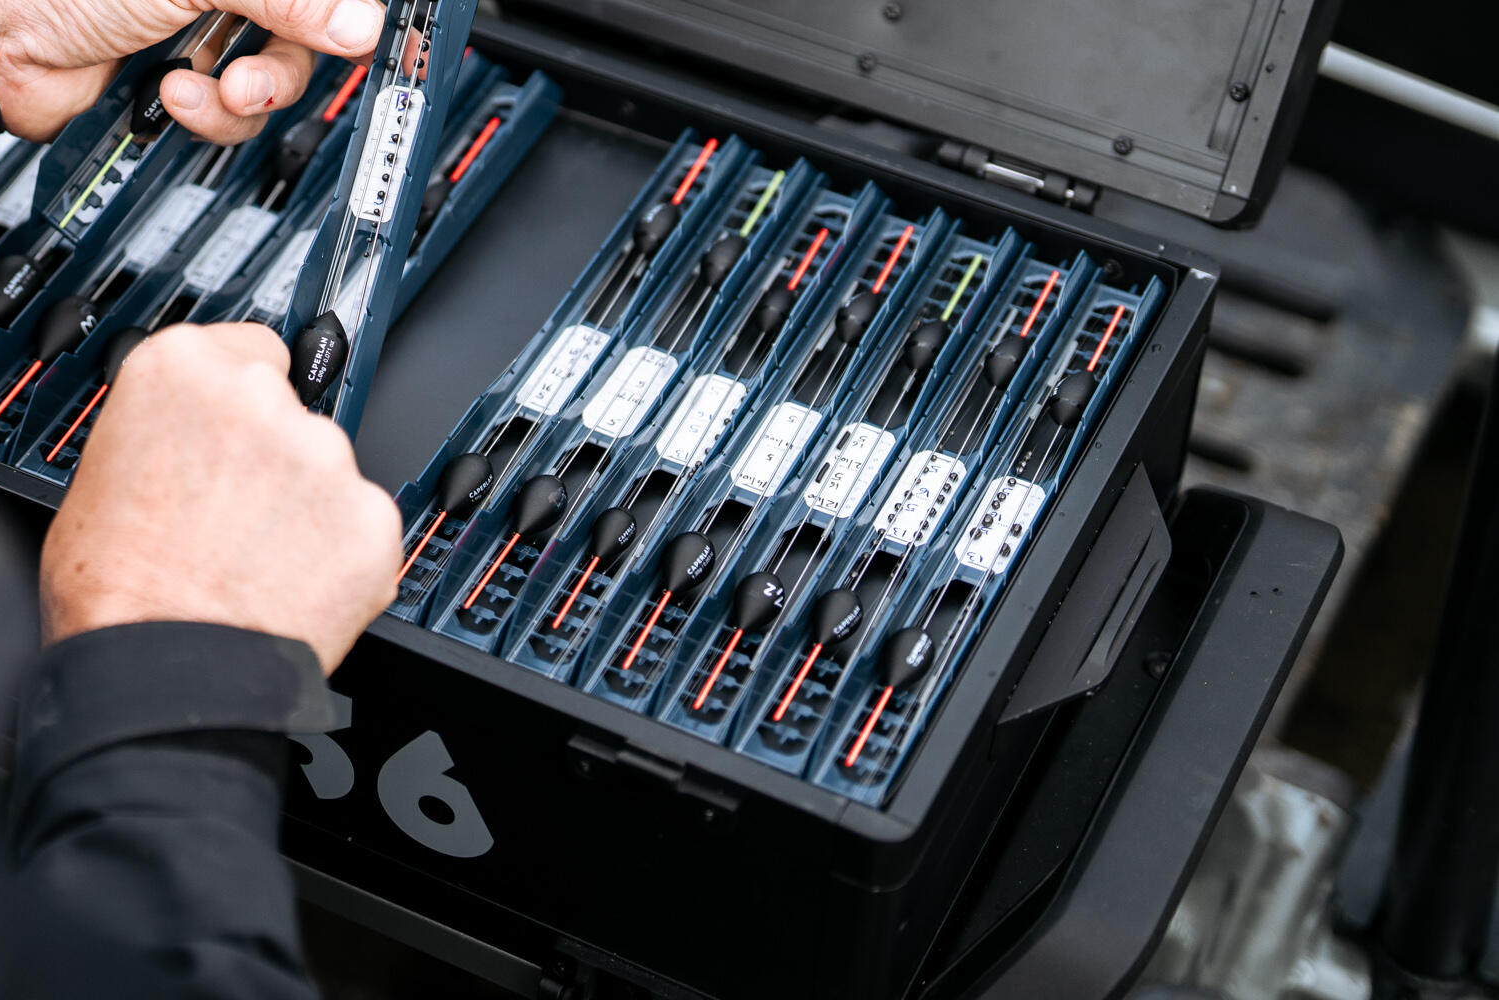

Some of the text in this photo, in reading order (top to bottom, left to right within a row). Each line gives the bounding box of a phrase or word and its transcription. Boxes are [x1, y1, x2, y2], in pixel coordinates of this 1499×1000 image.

[307, 336, 329, 381] CAPERLAN
[468, 473, 494, 499] CAPERLAN
[893, 527, 907, 538] 13
[686, 544, 711, 575] CAPERLAN
[966, 551, 983, 563] 13
